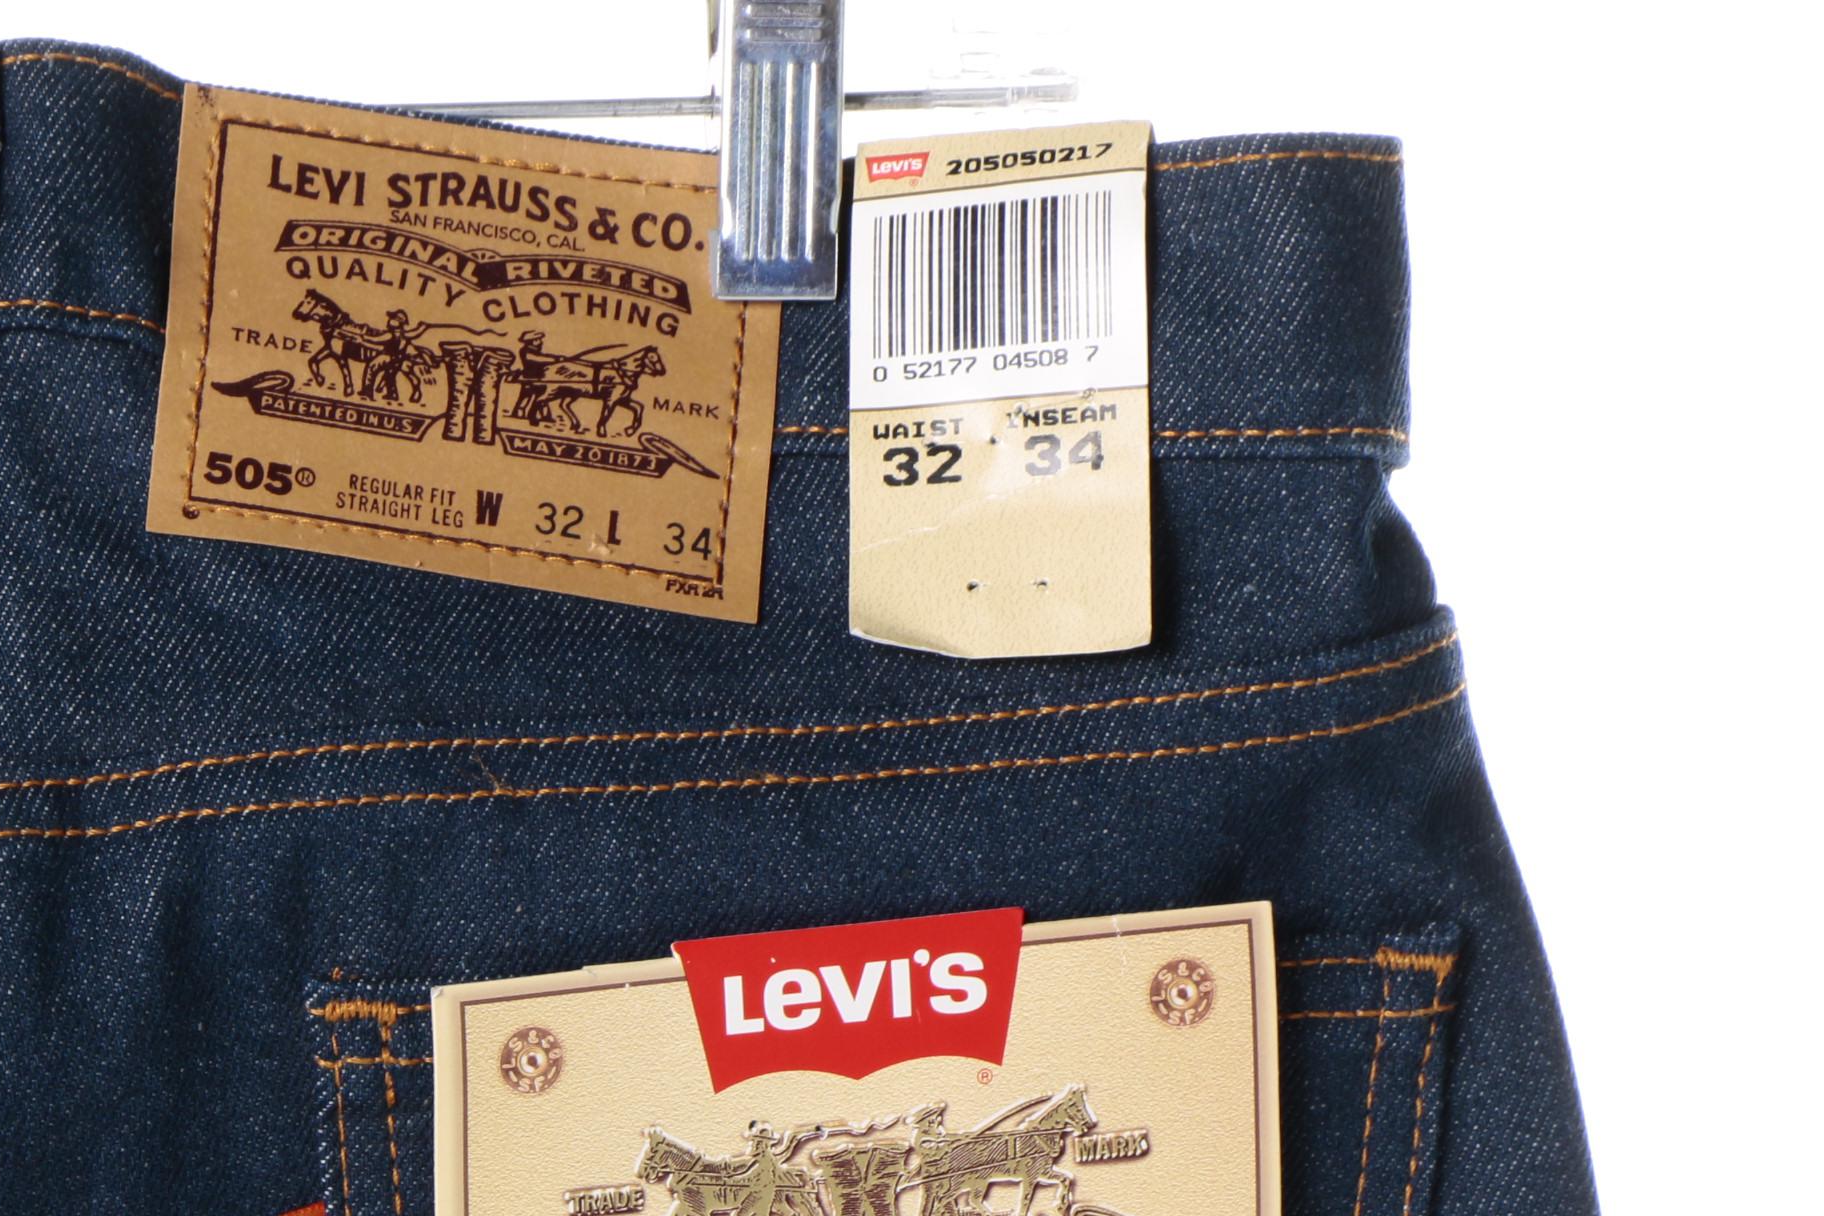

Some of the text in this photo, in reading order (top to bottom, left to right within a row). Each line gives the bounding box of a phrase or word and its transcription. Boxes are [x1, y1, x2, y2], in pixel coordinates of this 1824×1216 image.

[945, 142, 1114, 176] 205050217
[267, 153, 705, 251] LEVI STRAUSS & CO.
[389, 209, 585, 251] SAN FRANCISCO, CAL.
[291, 225, 679, 300] ORIGINAL RIVETED
[286, 255, 680, 338] QUALITY CLOTHING
[232, 327, 313, 353] TRADE
[872, 345, 1099, 383] 0 52177 04508 7
[261, 395, 357, 423] PATENTED
[362, 409, 378, 426] IN
[653, 396, 721, 419] MARK
[873, 417, 964, 440] WAIST
[514, 438, 657, 471] MAY 20 1873
[883, 443, 962, 487] 32
[1024, 430, 1105, 477] 34
[349, 474, 457, 506] REGULAR FIT
[336, 492, 464, 529] STRAIGHT LEG
[476, 489, 713, 561] W 32 L 34
[1074, 1129, 1150, 1162] MARK
[565, 1185, 646, 1216] TRADE
